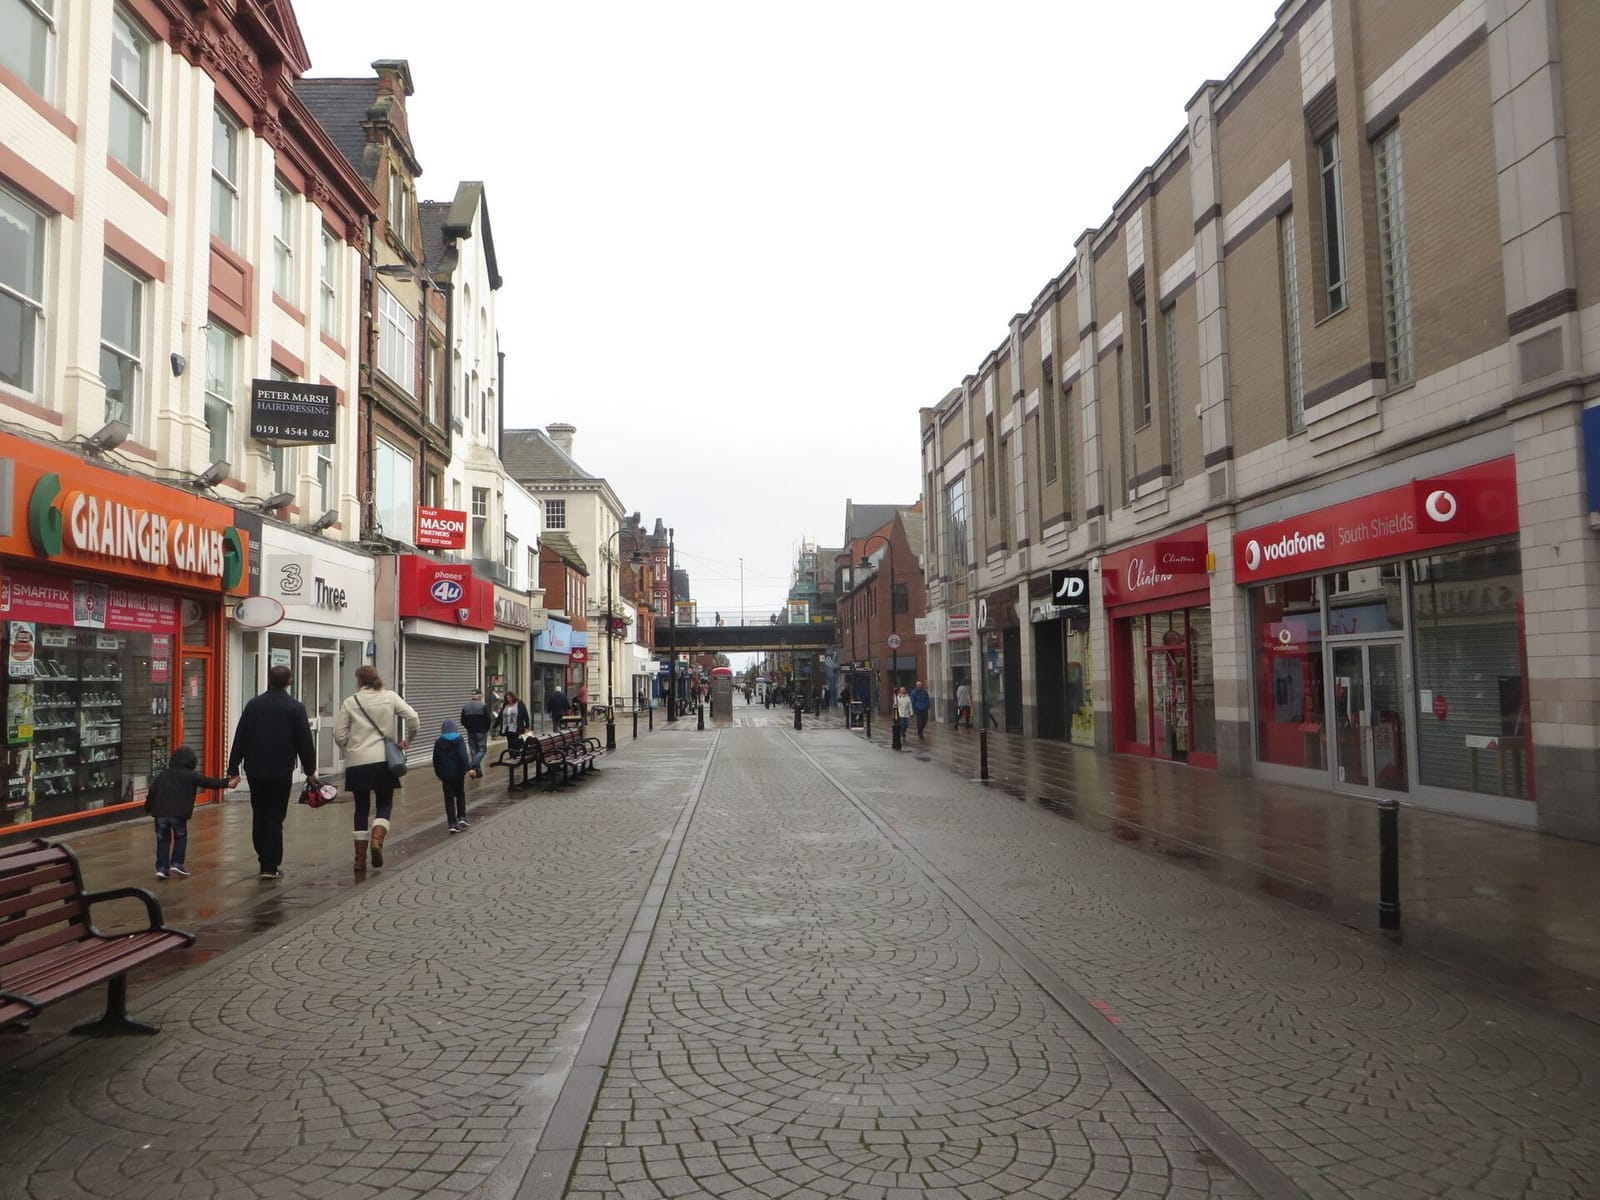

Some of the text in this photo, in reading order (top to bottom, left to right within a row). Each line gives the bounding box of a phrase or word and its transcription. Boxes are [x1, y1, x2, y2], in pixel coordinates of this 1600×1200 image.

[257, 389, 329, 404] PETER MARSH
[257, 402, 329, 415] HAIRDRESSING
[256, 425, 330, 438] 0191 4544 862
[420, 518, 464, 532] MASON
[71, 492, 225, 578] GRAINGER GAMES
[420, 529, 450, 538] PARTNERS
[1263, 512, 1414, 561] vodafone South Shields
[434, 570, 463, 581] phones
[1127, 557, 1174, 592] Clintons
[12, 583, 70, 601] SMARTFIX
[434, 582, 460, 601] 4u
[1056, 577, 1084, 598] JD
